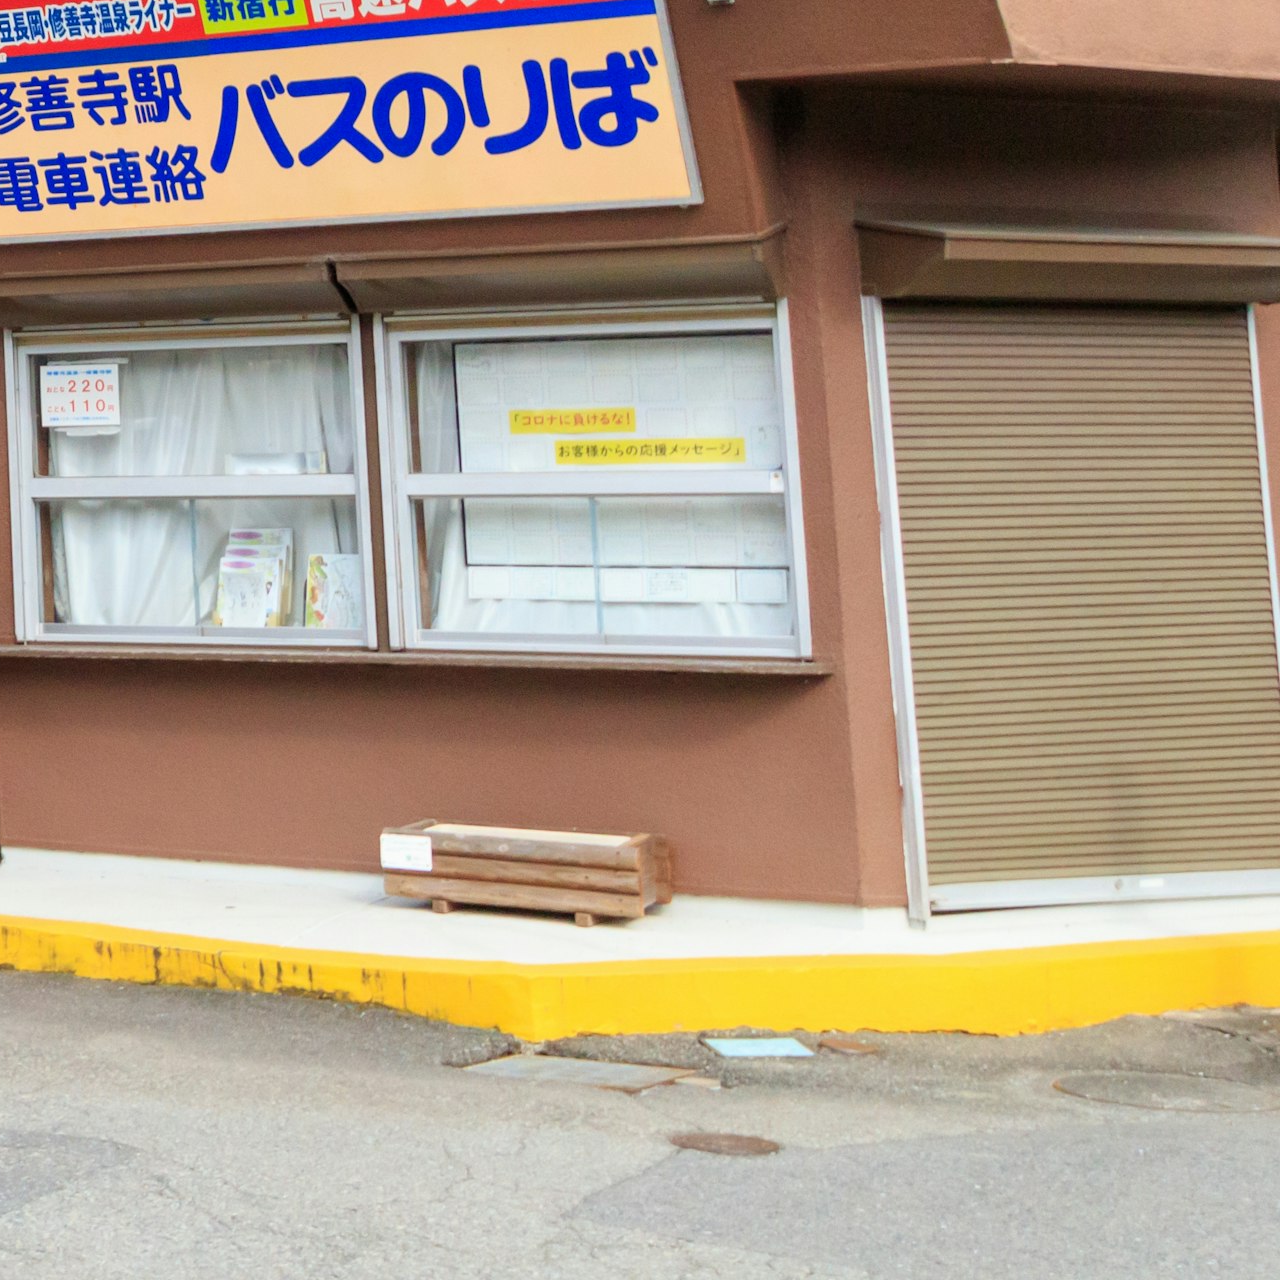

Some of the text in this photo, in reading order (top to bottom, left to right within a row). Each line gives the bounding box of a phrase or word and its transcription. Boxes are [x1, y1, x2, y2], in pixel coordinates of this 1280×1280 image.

[209, 46, 660, 174] バスのりば
[558, 443, 741, 457] お客様からの応援メッセージ」
